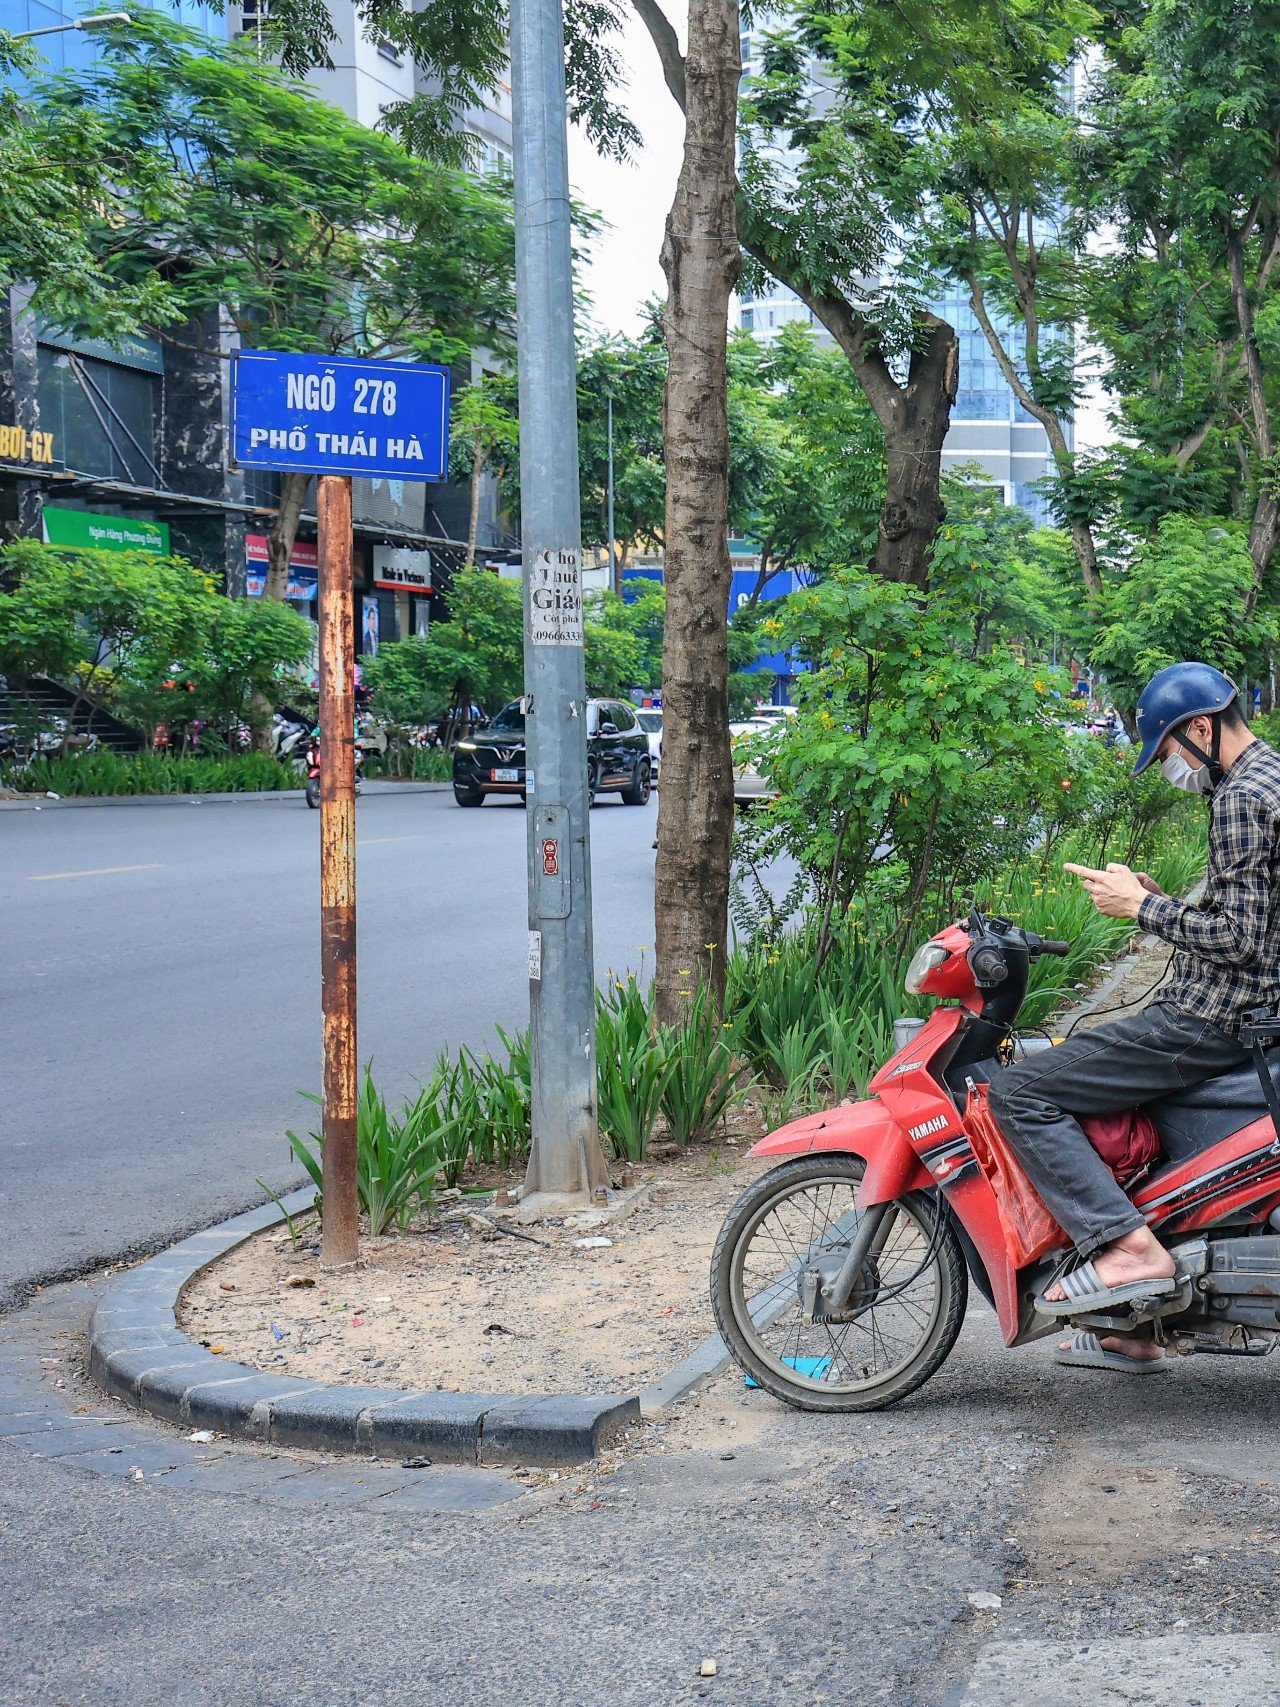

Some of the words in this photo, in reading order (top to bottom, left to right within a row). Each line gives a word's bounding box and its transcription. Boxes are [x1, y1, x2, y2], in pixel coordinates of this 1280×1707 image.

[287, 368, 336, 412] NGÕ
[353, 377, 397, 416] 278
[250, 424, 309, 452] PHỐ
[315, 430, 377, 457] THÁI
[386, 433, 424, 460] HÀ
[908, 1114, 949, 1142] YAMAHA
